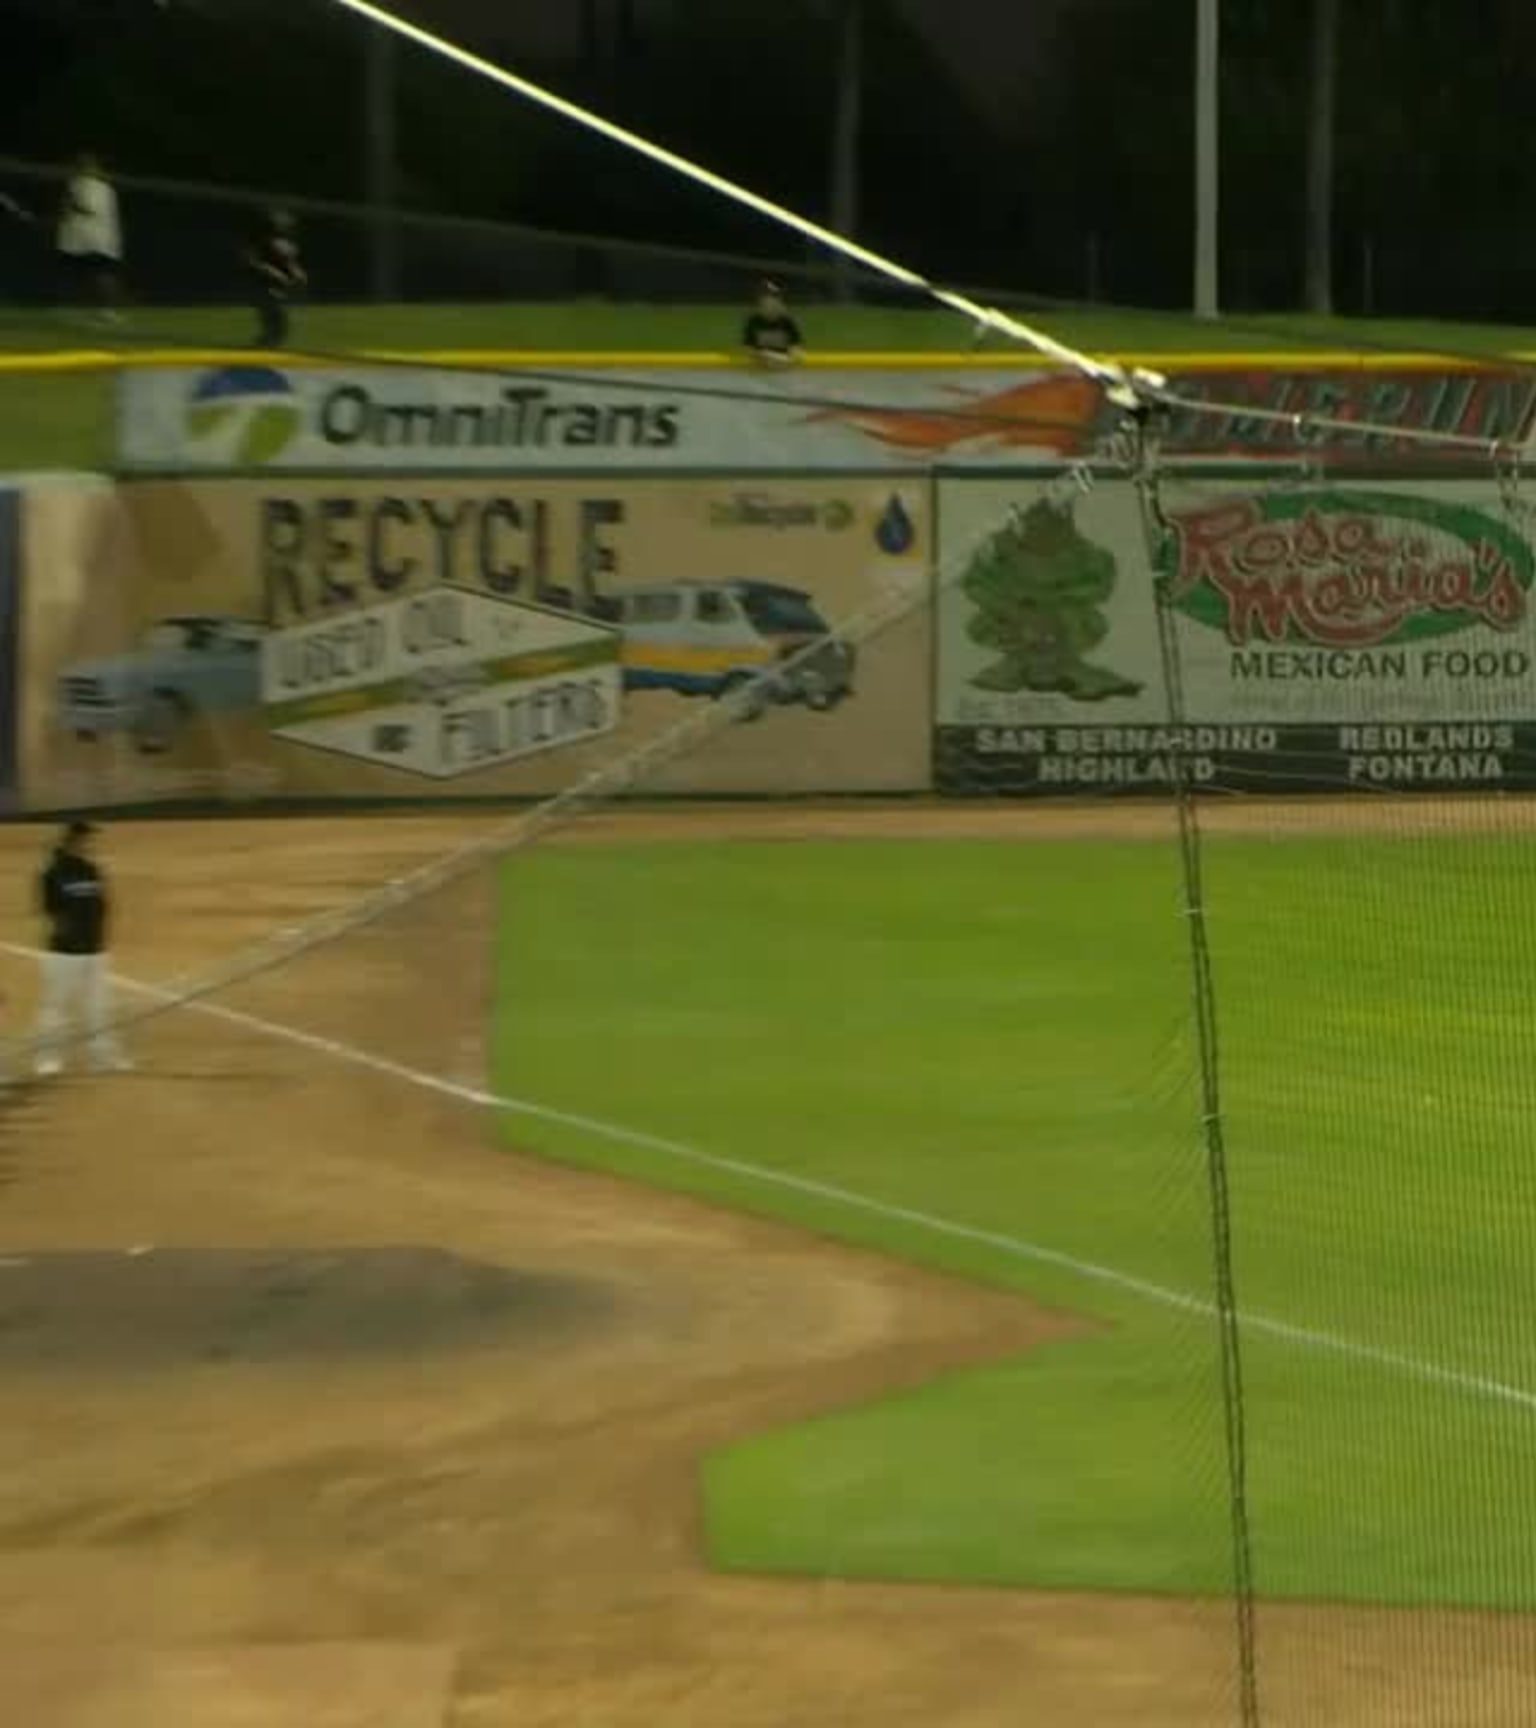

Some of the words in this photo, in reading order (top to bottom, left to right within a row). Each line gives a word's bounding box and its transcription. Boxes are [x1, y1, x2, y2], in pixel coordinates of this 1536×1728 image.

[319, 386, 680, 449] OmniTrans
[259, 500, 626, 626] RECYCLE
[1170, 505, 1372, 595] Rosa
[1226, 543, 1527, 647] Maria's
[1230, 650, 1406, 682] MEXICAN
[1423, 650, 1529, 680] FOOD
[976, 730, 1046, 753] SAN
[1339, 726, 1515, 751] REDLANDS
[1348, 754, 1503, 780] FONTANA
